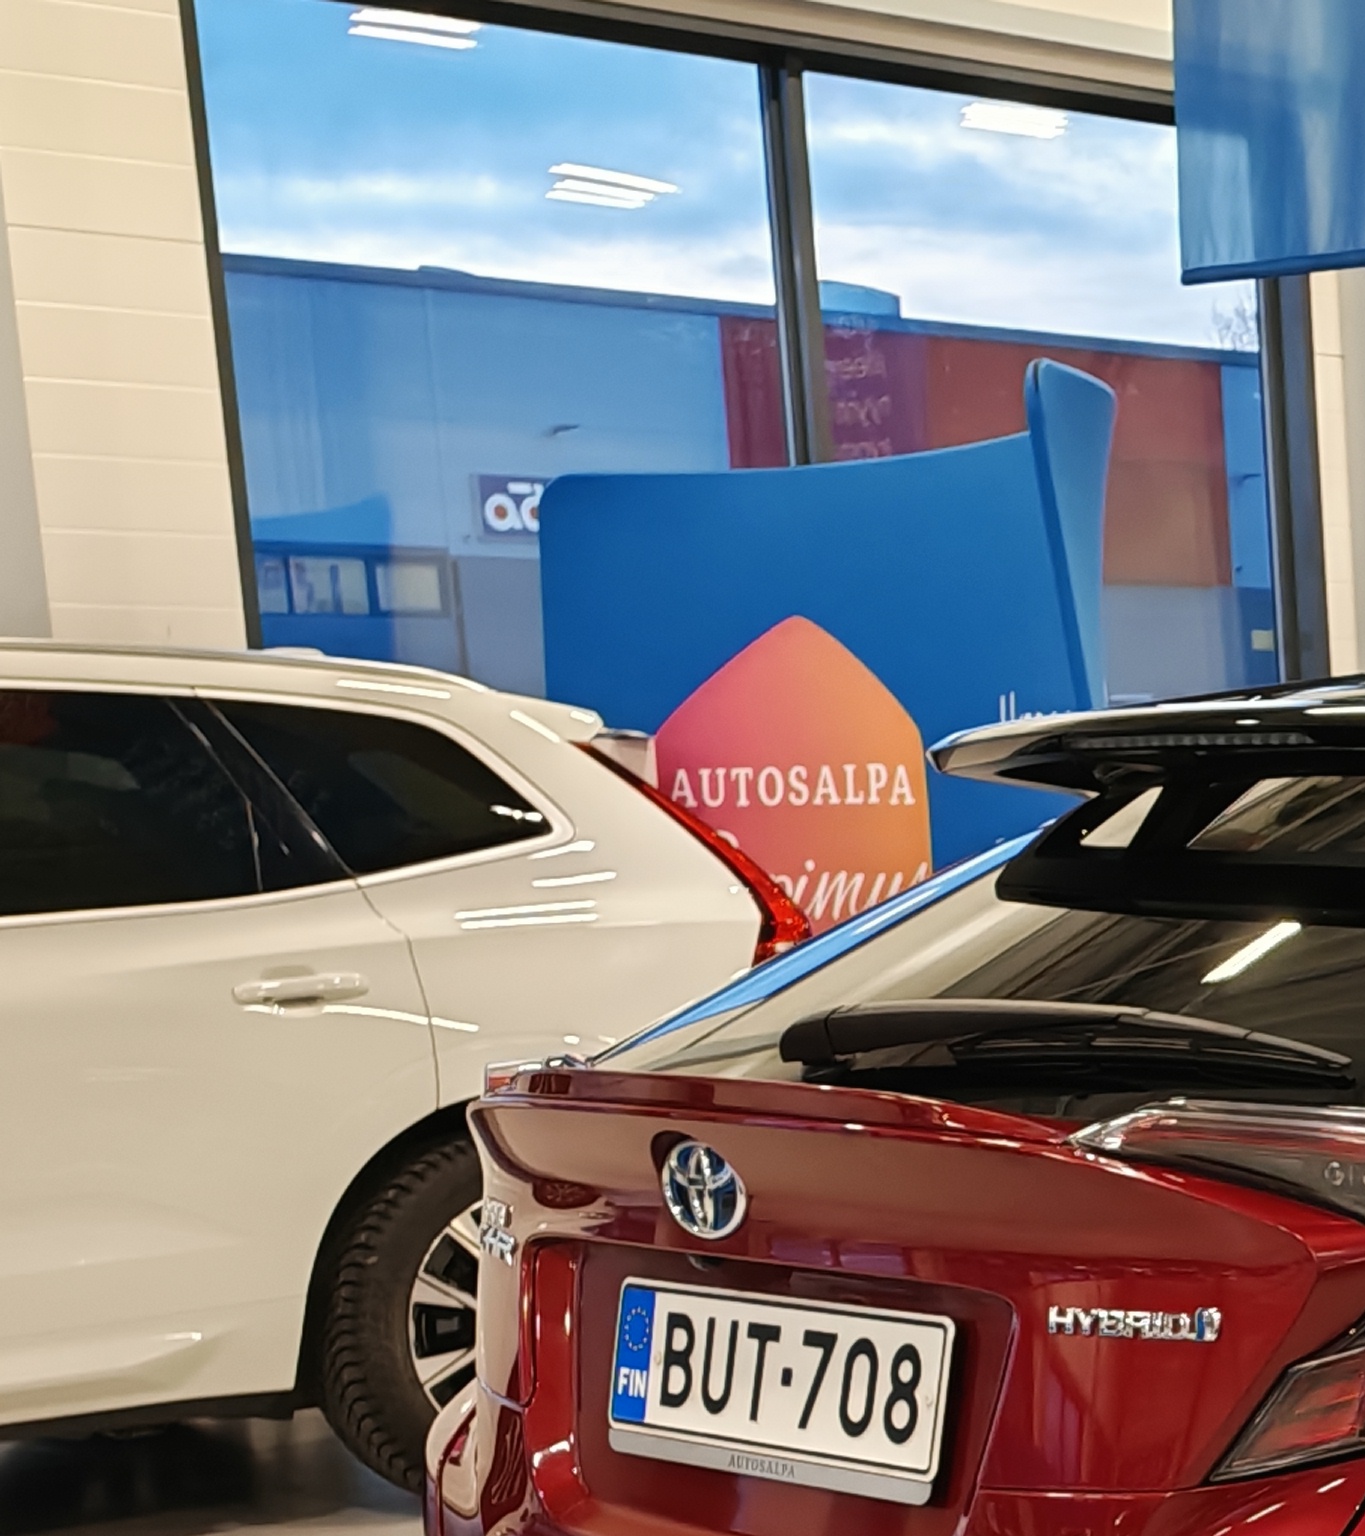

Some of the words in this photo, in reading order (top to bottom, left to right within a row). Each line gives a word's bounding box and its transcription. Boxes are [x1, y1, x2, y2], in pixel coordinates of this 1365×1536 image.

[671, 763, 916, 808] AUTOSALPA
[616, 1366, 648, 1399] FIN
[659, 1311, 922, 1445] BUT-708
[727, 1453, 796, 1480] AUTOSALPA
